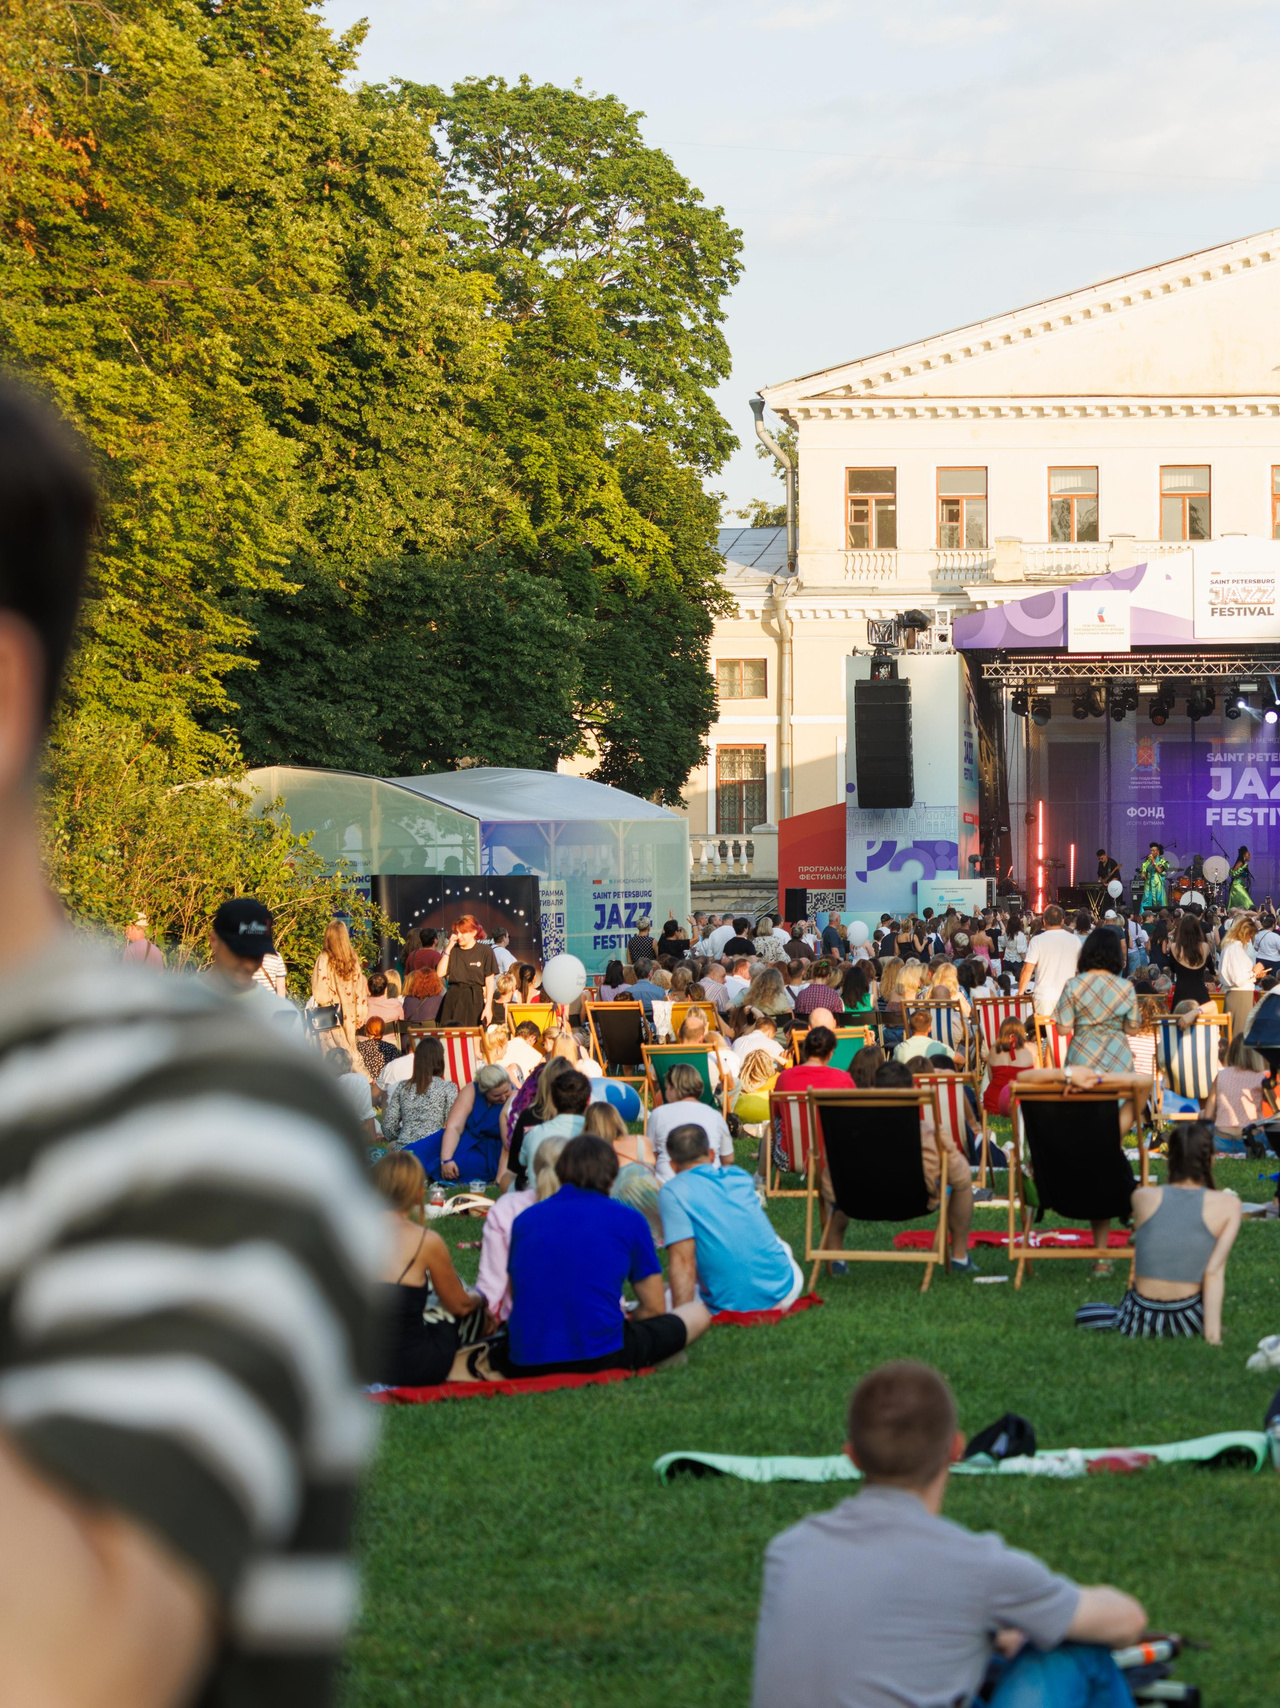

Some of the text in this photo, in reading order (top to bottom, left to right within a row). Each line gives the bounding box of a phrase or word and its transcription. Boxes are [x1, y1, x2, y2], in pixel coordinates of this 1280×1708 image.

[1208, 586, 1275, 605] JAZZ
[1210, 607, 1275, 616] FESTIVAL
[1206, 752, 1244, 762] SAINT
[1126, 807, 1165, 819] ФОНД
[592, 890, 653, 900] SAINT PETERSBURG
[593, 902, 653, 931] JAZZ
